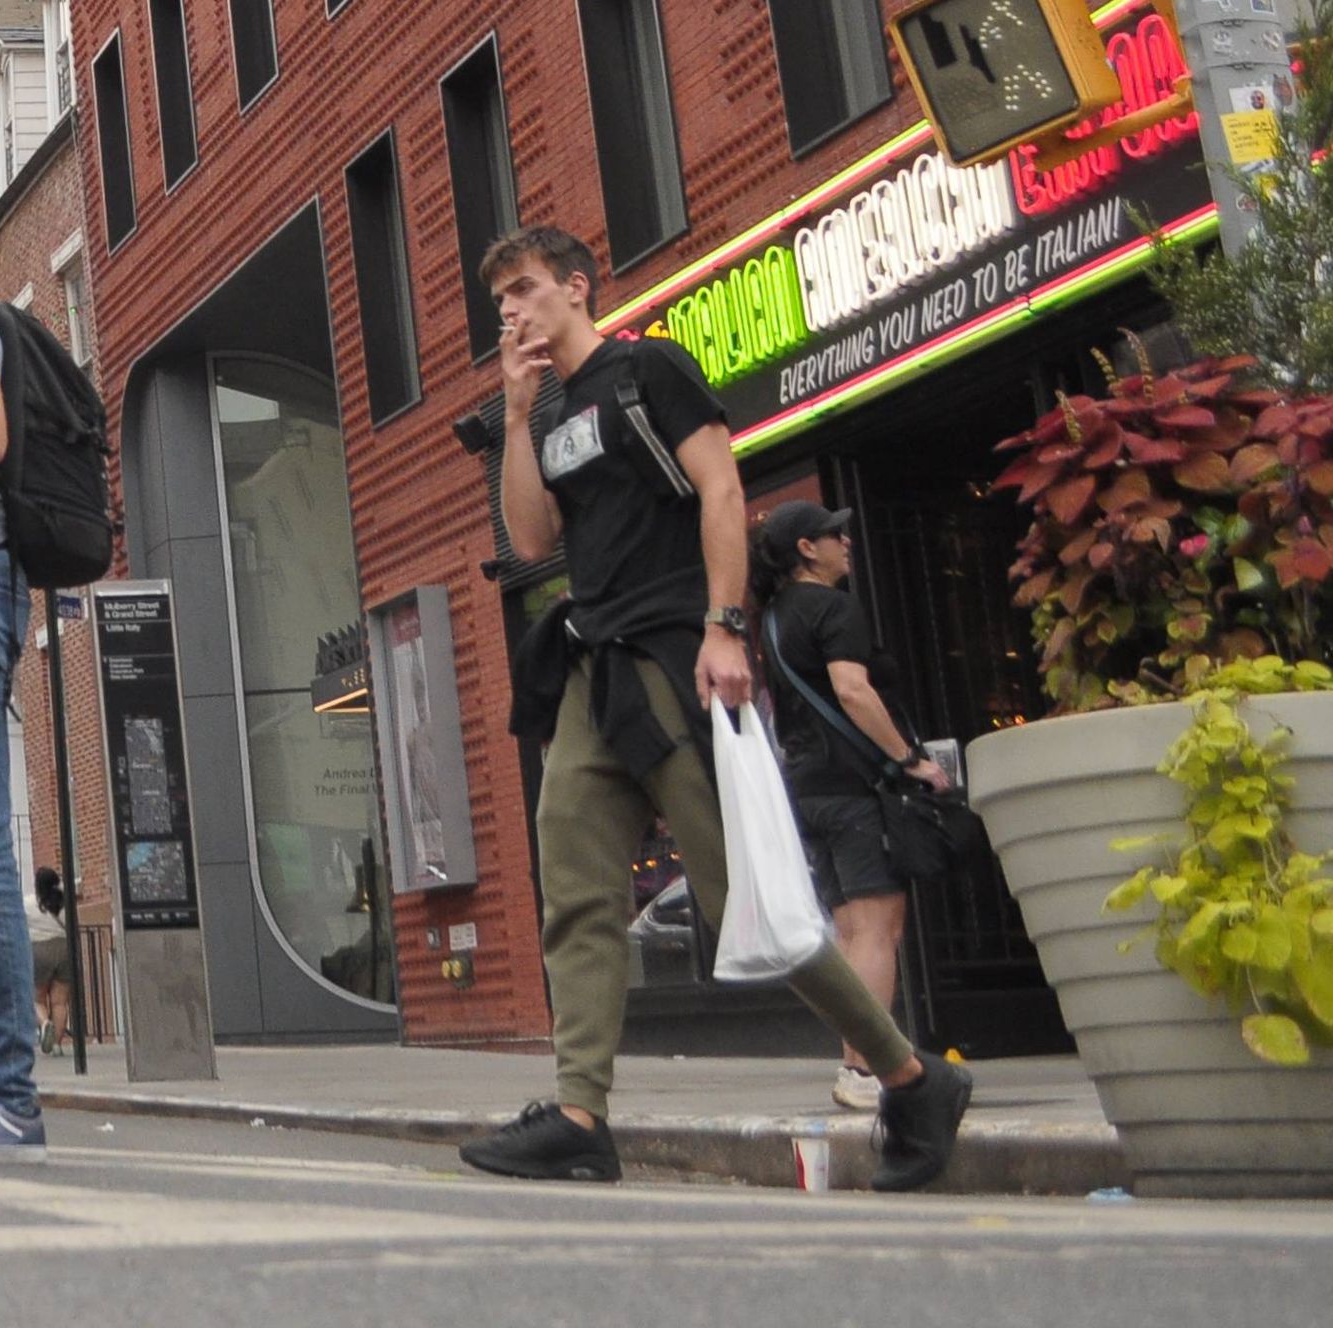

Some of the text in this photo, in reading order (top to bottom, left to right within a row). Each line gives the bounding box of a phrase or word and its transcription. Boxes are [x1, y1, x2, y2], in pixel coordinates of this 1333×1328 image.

[779, 197, 1121, 406] EVERYTHING YOU NEED TO BE ITALIAN!
